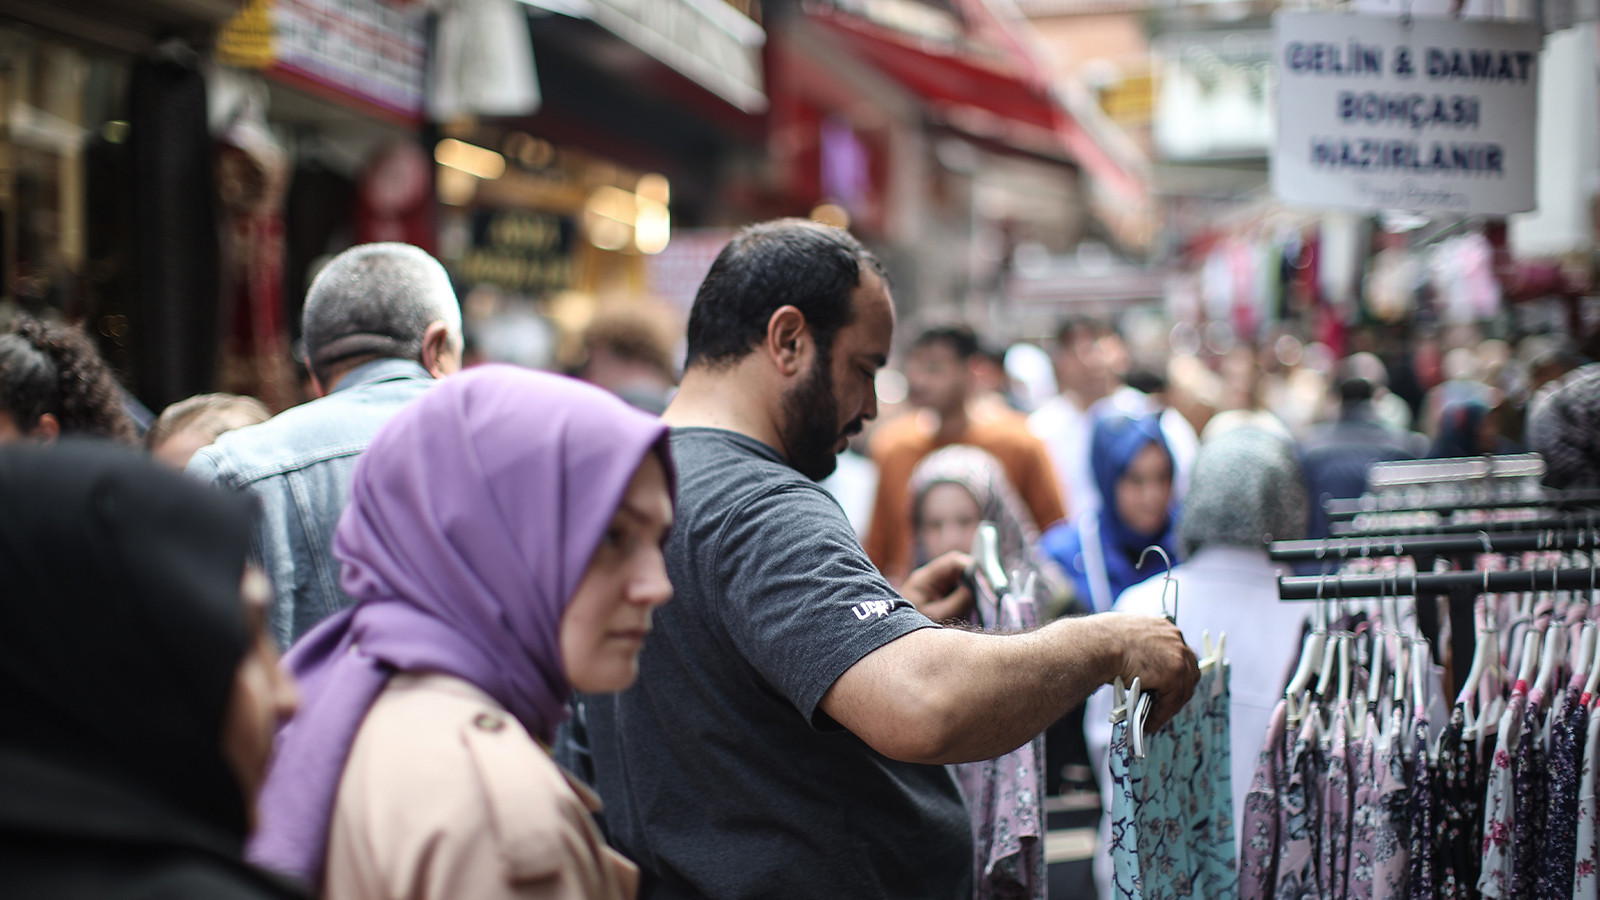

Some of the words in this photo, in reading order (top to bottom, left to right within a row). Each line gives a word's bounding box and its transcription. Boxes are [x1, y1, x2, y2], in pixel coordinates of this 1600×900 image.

[1286, 40, 1381, 74] GELİN
[1393, 47, 1415, 77] &
[1426, 49, 1534, 83] DAMAT
[1337, 91, 1480, 129] BOHÇASI
[1310, 140, 1504, 174] HAZIRLANIR
